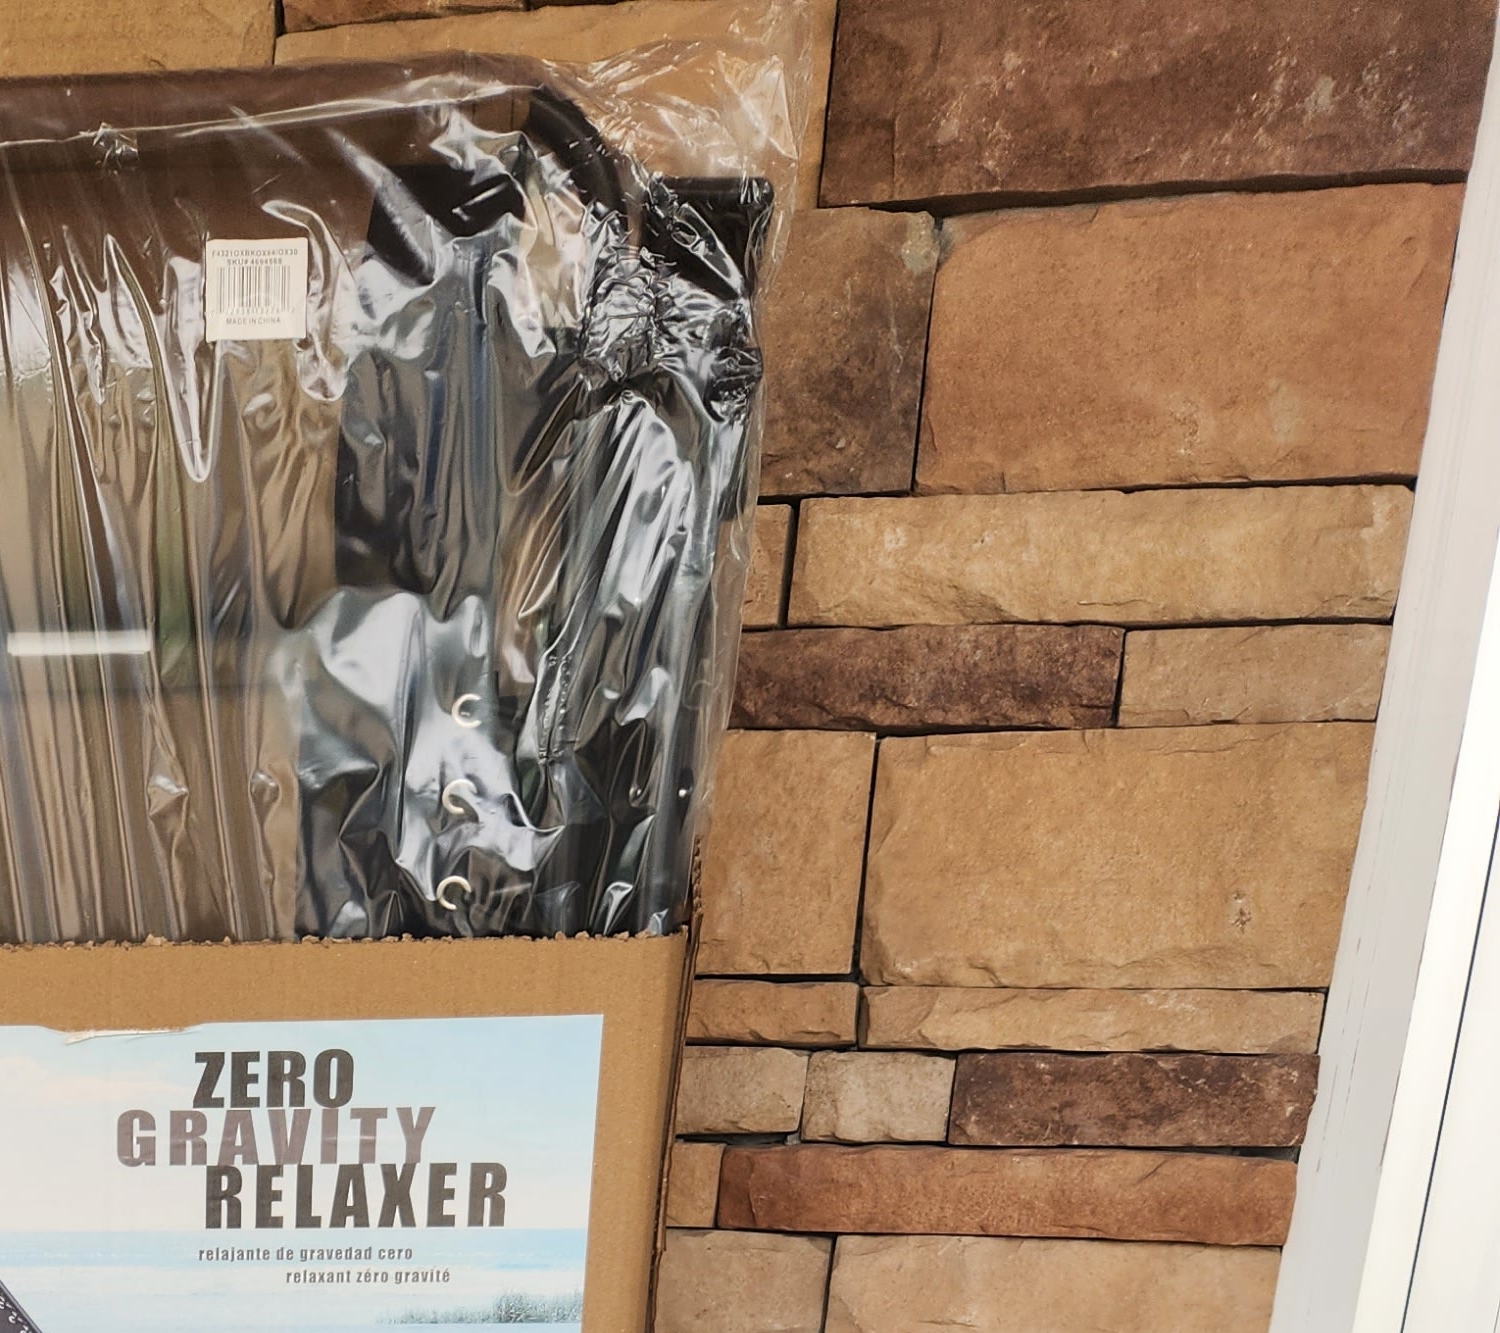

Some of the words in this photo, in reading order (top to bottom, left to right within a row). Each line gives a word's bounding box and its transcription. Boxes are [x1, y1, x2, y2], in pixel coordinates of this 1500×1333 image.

[193, 1048, 354, 1108] ZERO
[117, 1107, 436, 1167] GRAVITY
[205, 1162, 507, 1229] RELAXER
[199, 1247, 271, 1262] relajante
[276, 1247, 294, 1260] de
[299, 1247, 372, 1262] gravedad
[378, 1248, 413, 1260] cero
[286, 1270, 351, 1283] relaxant
[356, 1268, 389, 1283] zéro
[394, 1268, 450, 1284] gravité
